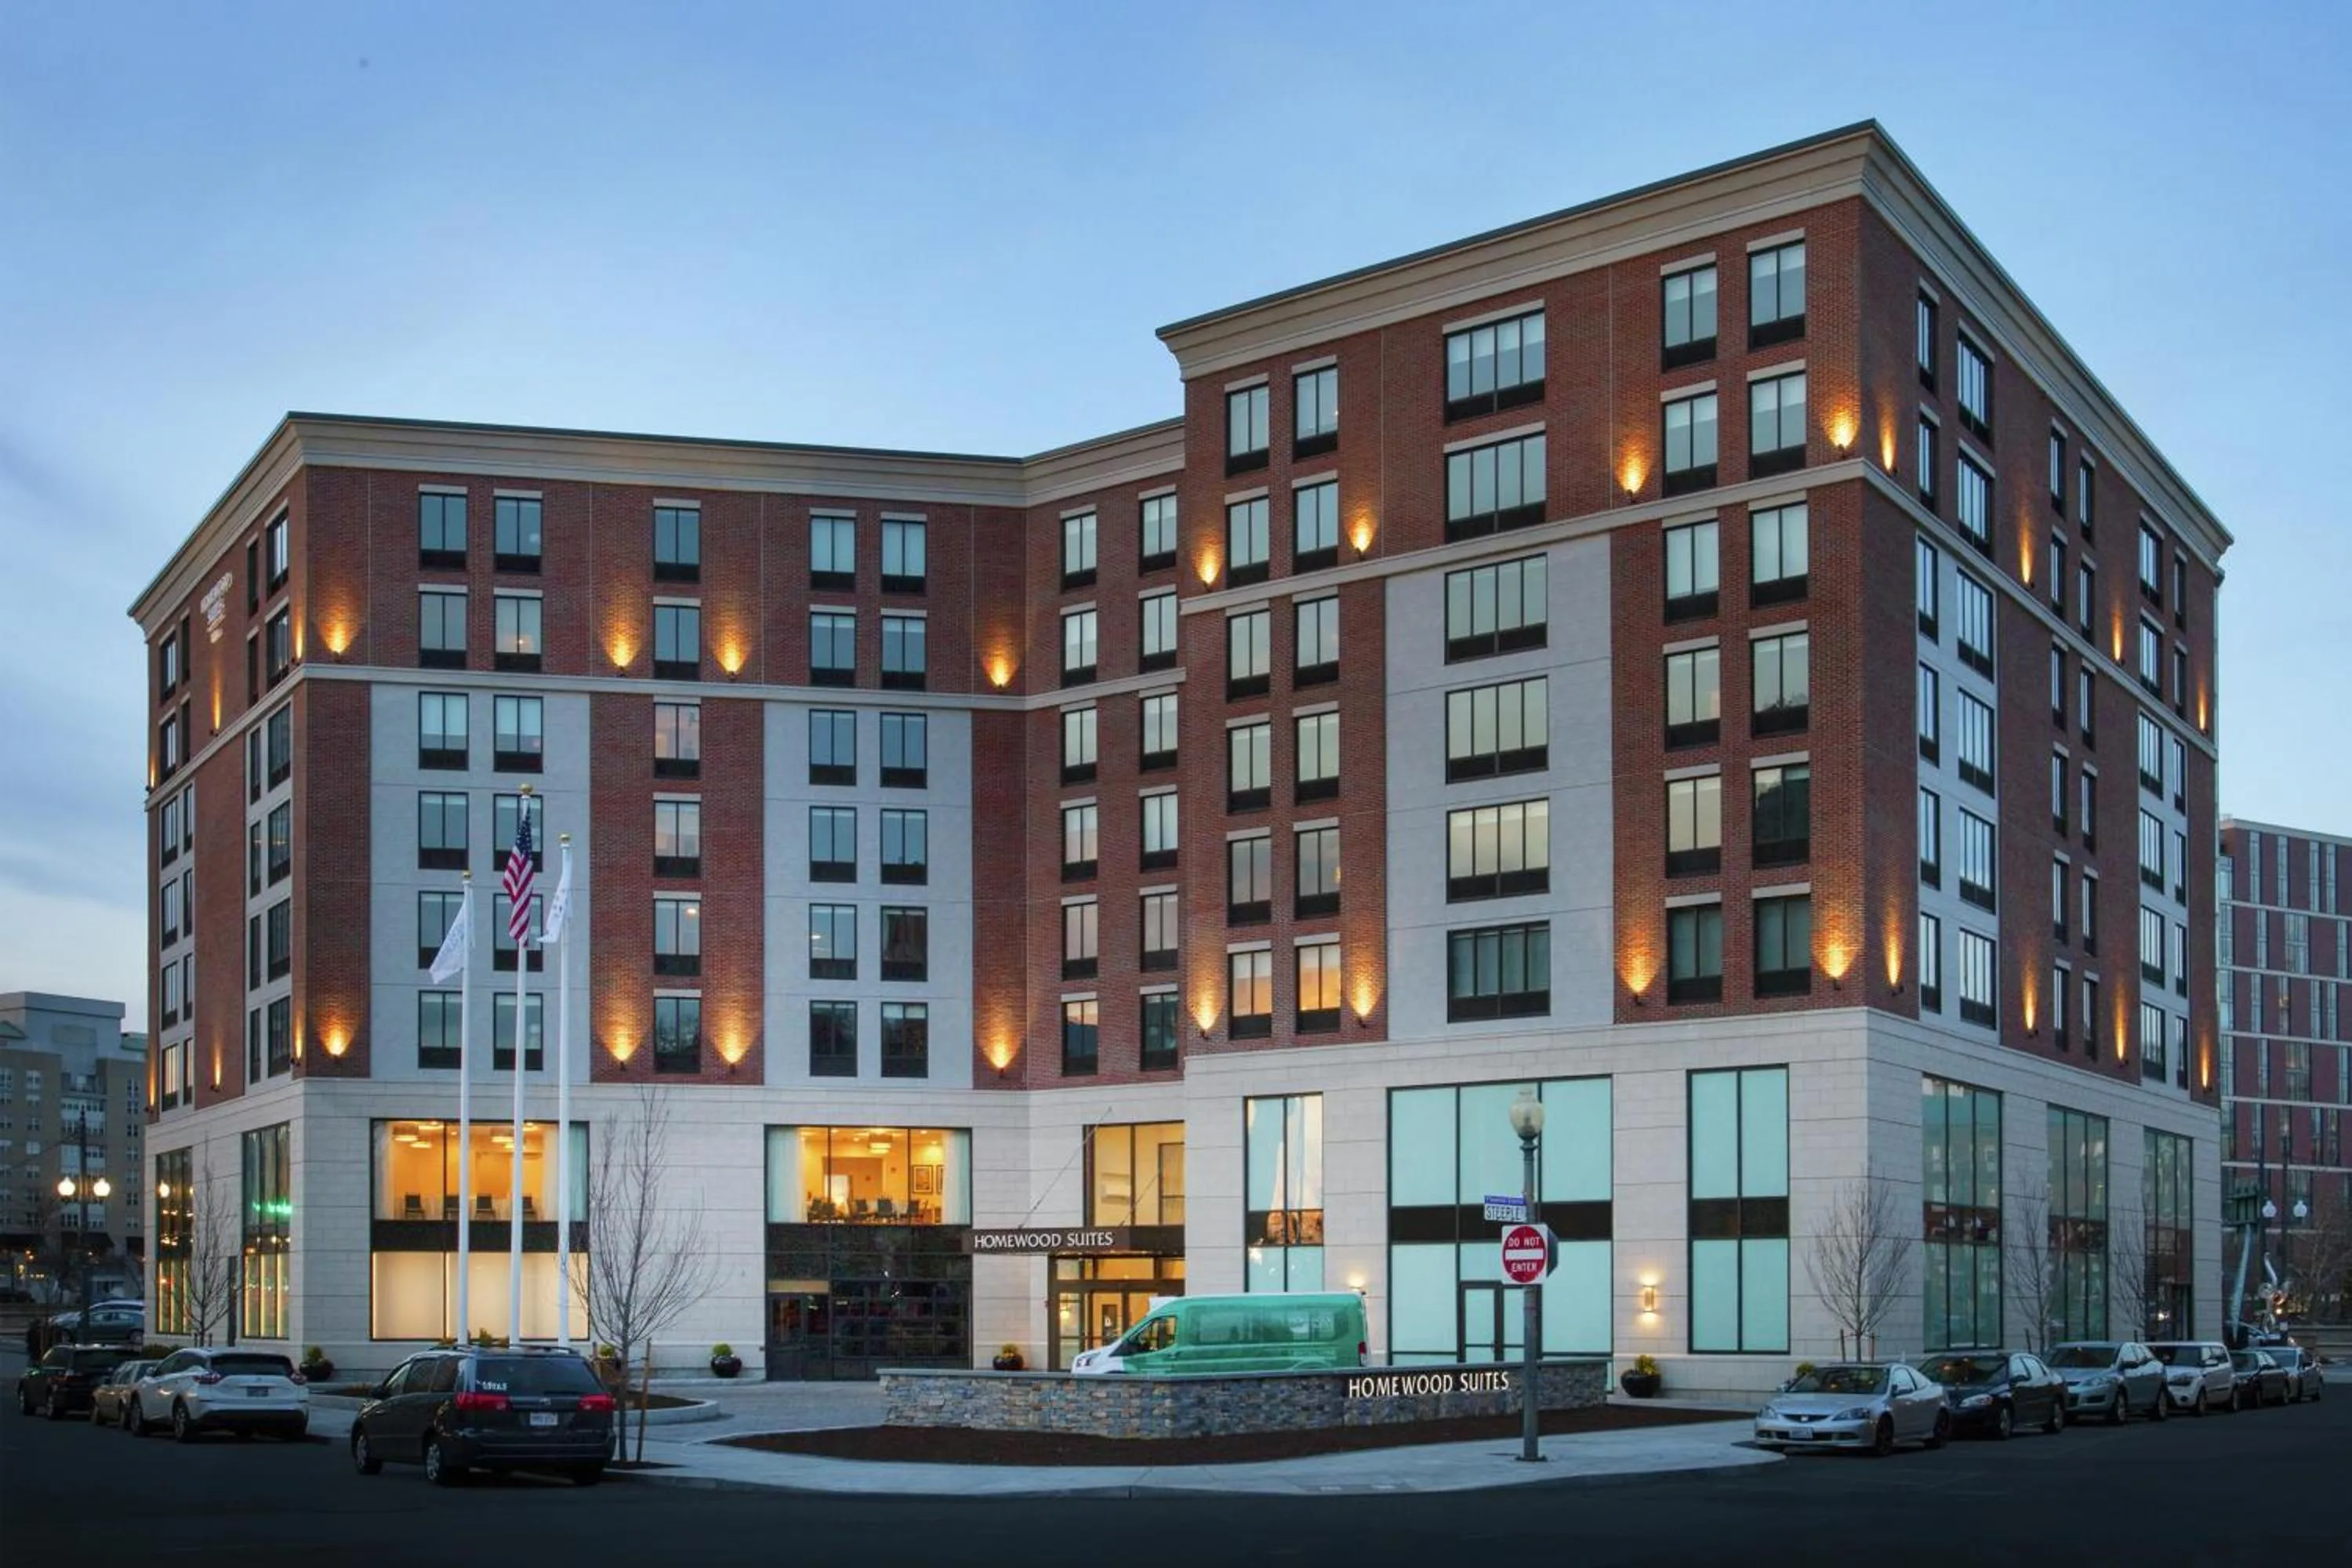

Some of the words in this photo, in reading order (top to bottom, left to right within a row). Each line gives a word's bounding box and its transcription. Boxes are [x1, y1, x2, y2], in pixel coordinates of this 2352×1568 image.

[975, 1233, 1062, 1248] HOMEWOOD
[1067, 1232, 1113, 1246] SUITES
[1508, 1237, 1520, 1247] DO
[1523, 1237, 1540, 1247] NOT
[1511, 1262, 1537, 1272] ENTER
[1348, 1374, 1454, 1399] HOMEWOOD
[1460, 1371, 1509, 1392] SUITES
